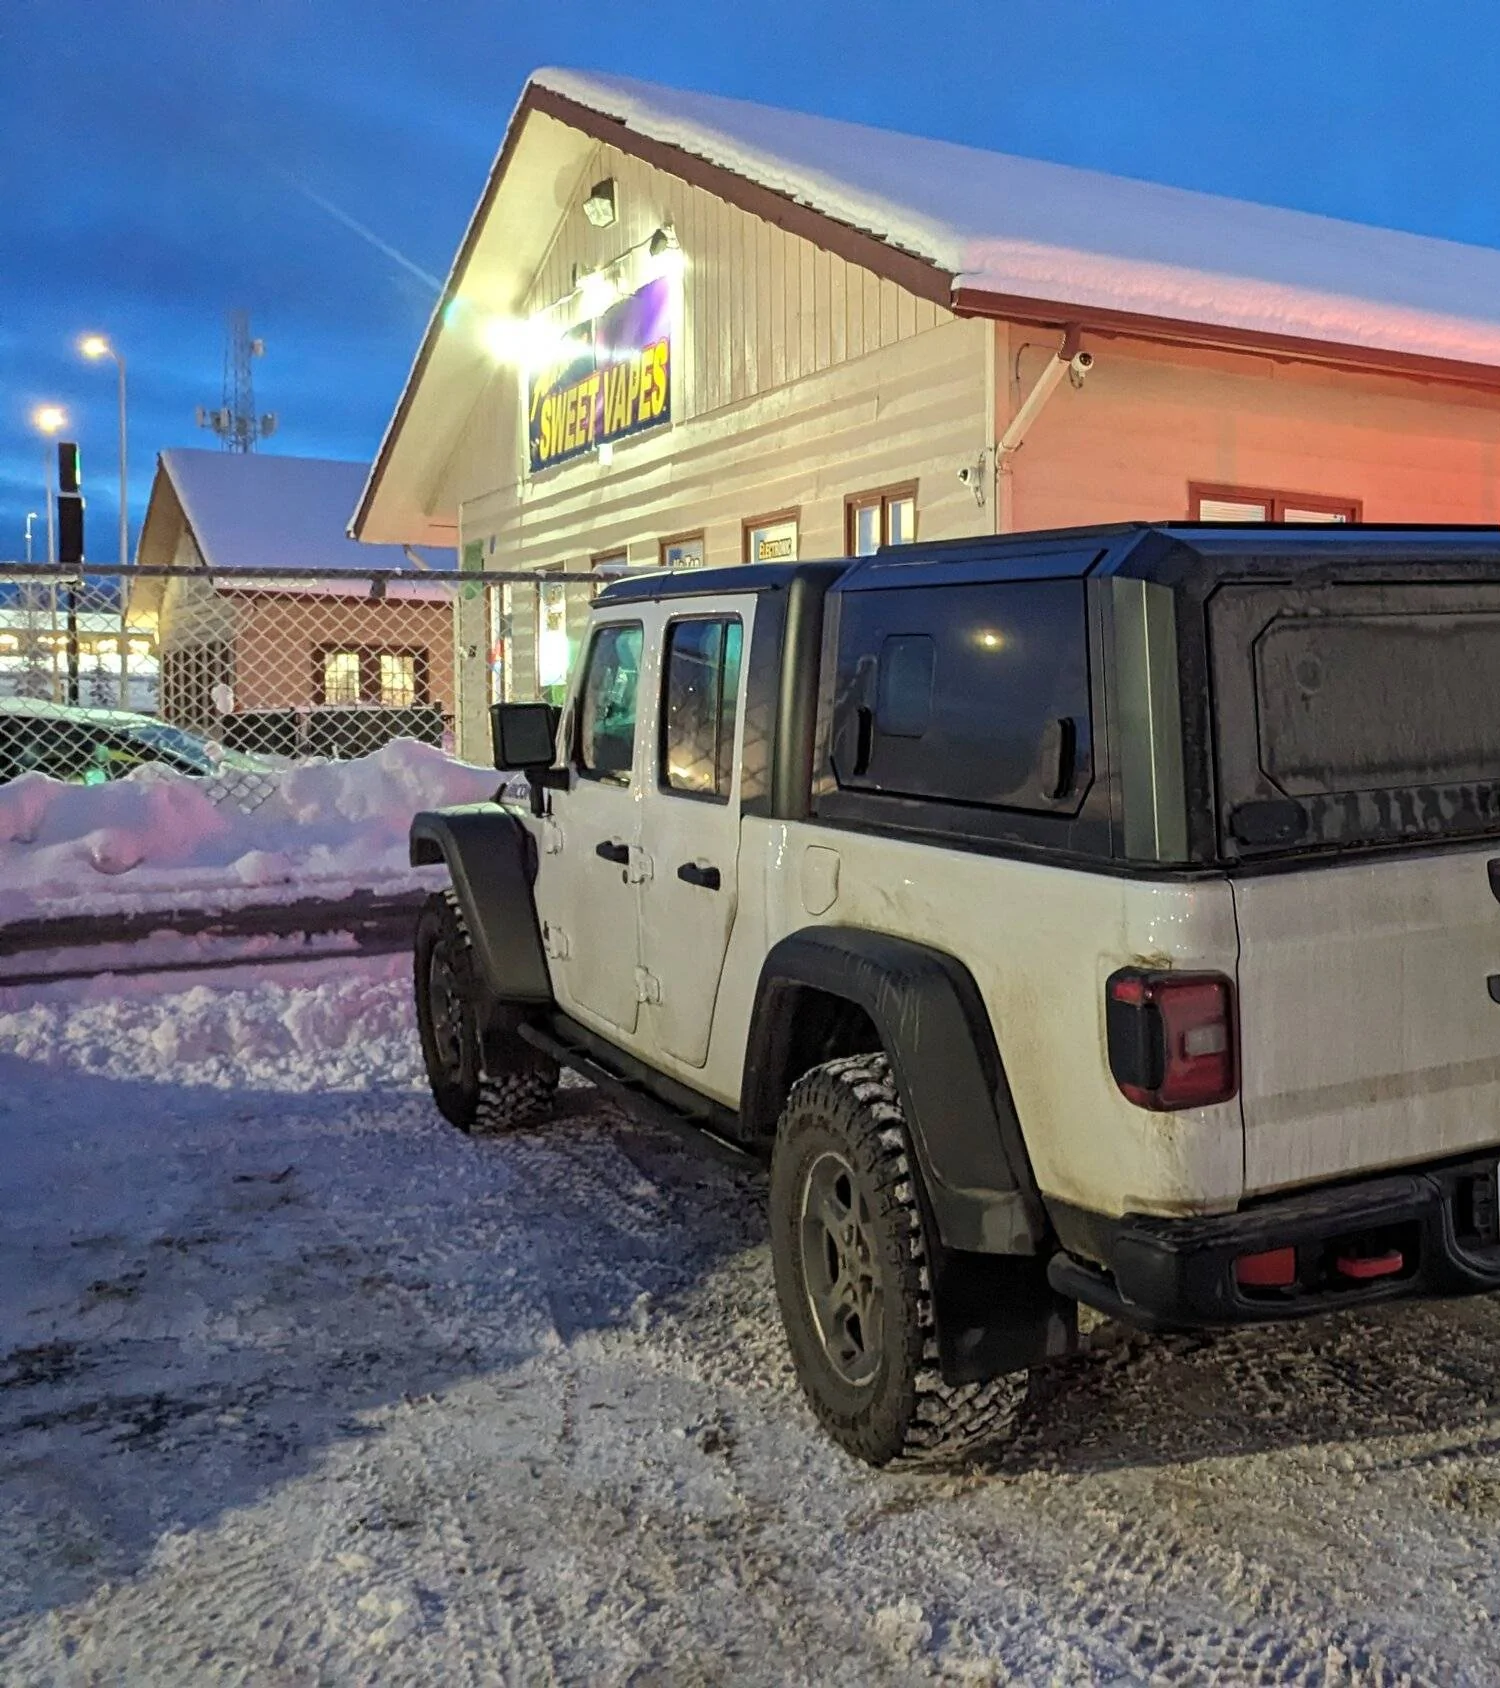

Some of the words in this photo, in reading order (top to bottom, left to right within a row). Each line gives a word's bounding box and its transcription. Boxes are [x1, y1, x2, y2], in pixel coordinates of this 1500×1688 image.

[539, 373, 600, 461] SWEET
[603, 339, 669, 436] VAPES
[759, 537, 792, 561] ELECTRONIC
